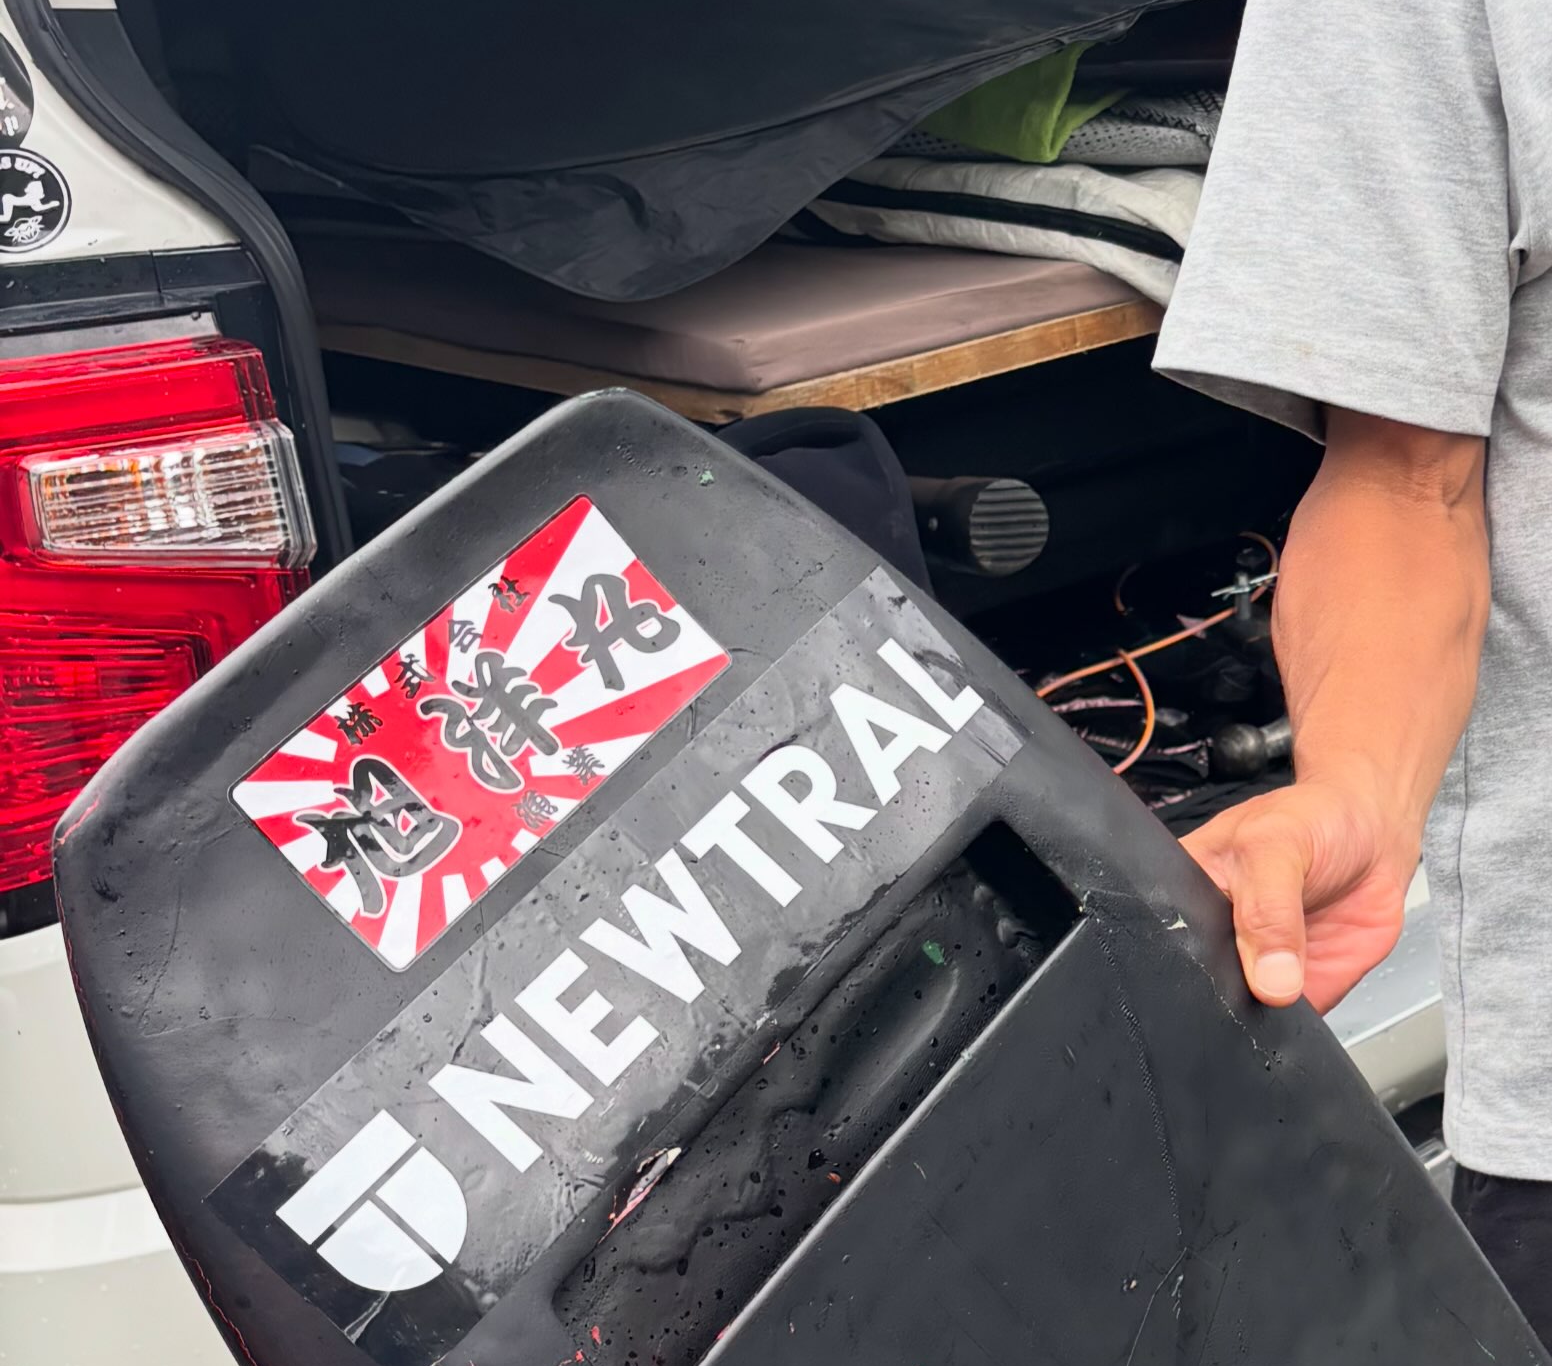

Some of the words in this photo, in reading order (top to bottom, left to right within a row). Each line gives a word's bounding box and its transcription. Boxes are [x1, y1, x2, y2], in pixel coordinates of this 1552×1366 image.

[294, 572, 682, 915] 旭洋丸
[335, 574, 531, 745] 株式会社
[512, 743, 606, 831] 漁業
[428, 637, 985, 1174] NEWTRAL
